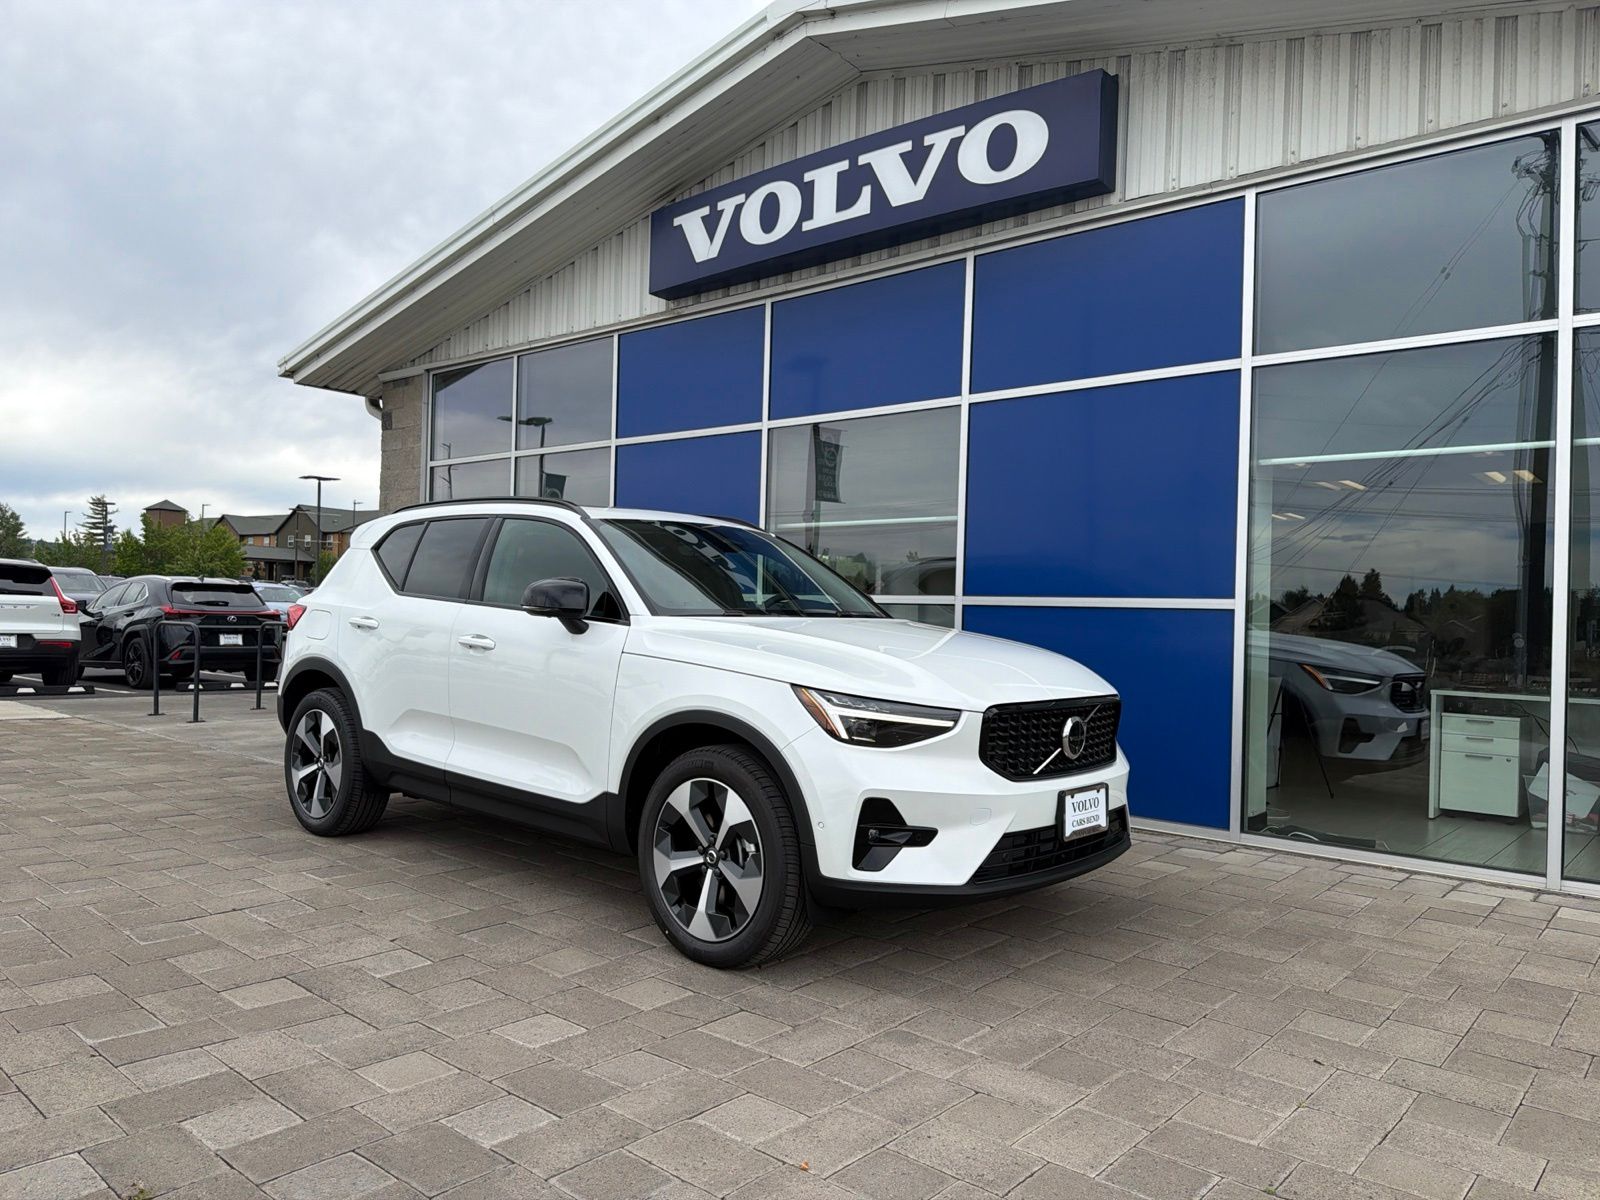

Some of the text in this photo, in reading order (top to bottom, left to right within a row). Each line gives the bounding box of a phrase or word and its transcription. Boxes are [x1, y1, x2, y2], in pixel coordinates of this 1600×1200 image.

[673, 109, 1049, 263] VOLVO
[1071, 797, 1100, 813] VOLVO
[1071, 814, 1100, 828] CARS BEND
